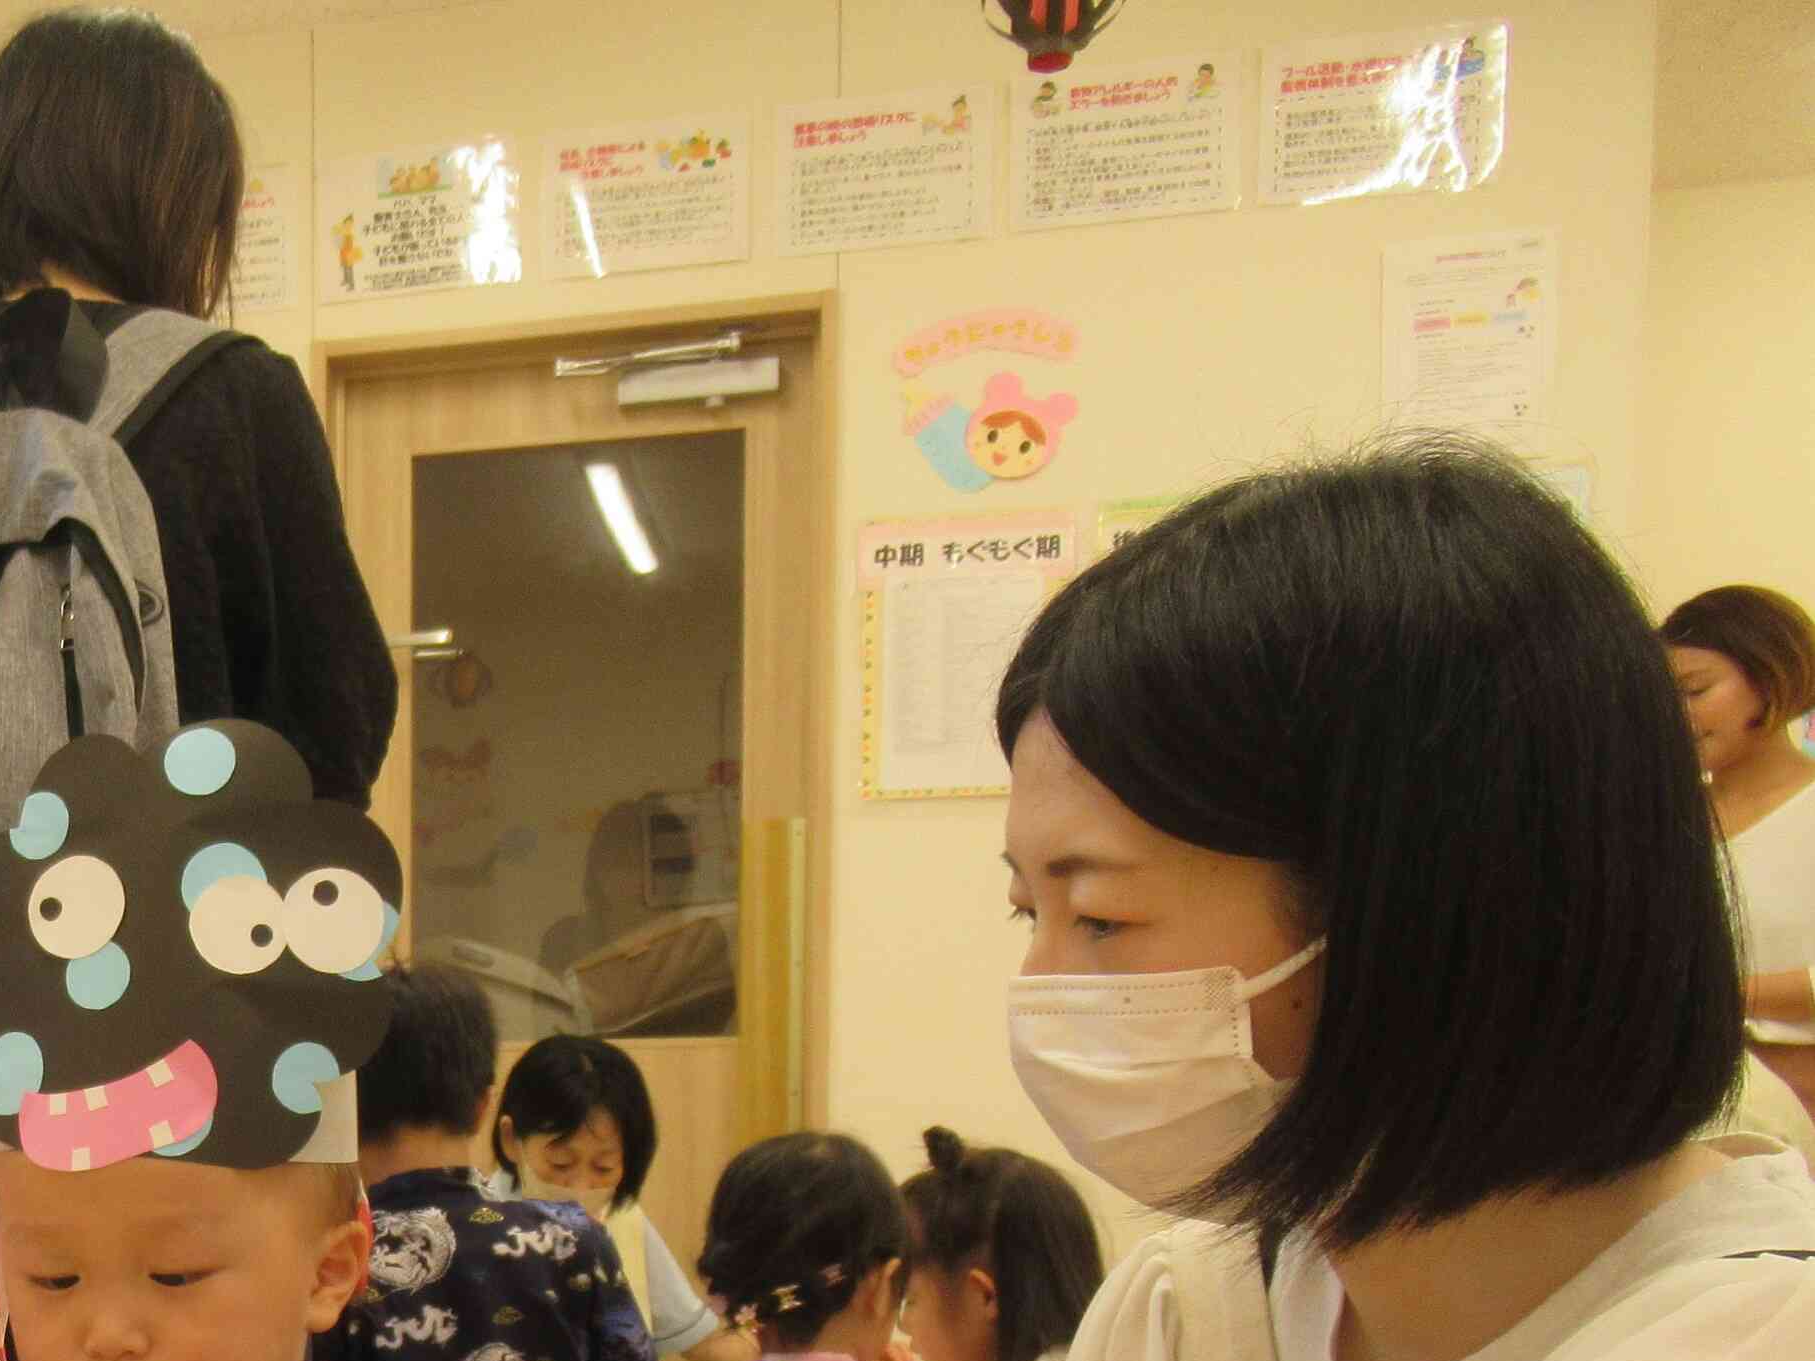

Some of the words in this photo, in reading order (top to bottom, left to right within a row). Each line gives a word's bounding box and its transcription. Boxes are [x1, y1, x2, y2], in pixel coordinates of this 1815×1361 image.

[874, 543, 924, 569] 中期
[942, 534, 1062, 563] もぐもぐ期
